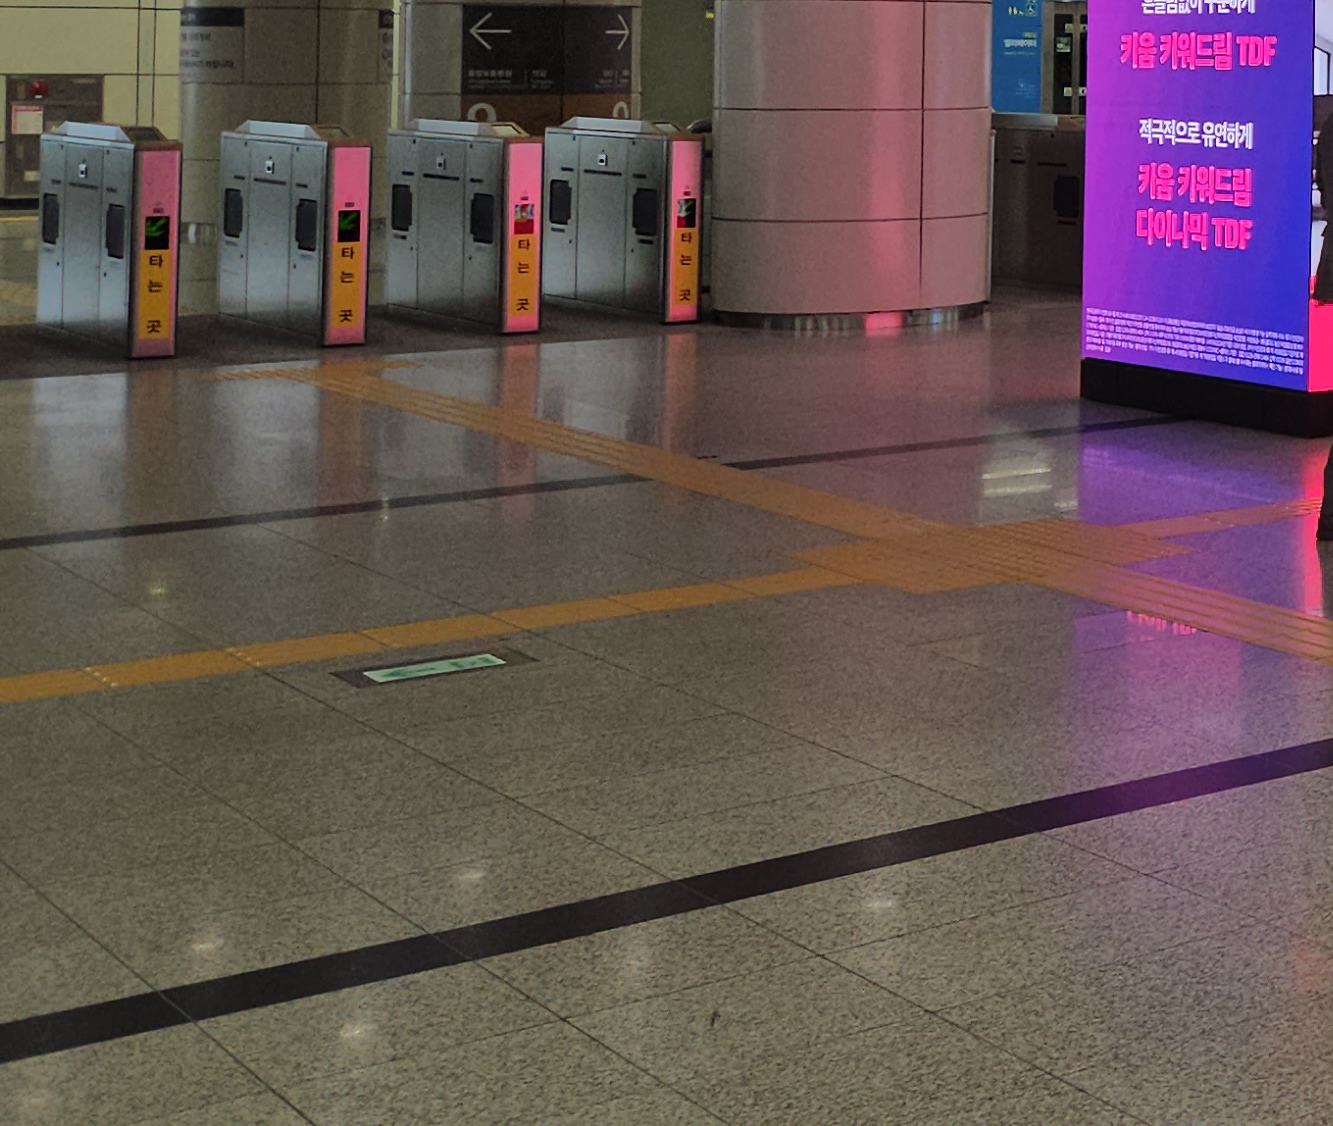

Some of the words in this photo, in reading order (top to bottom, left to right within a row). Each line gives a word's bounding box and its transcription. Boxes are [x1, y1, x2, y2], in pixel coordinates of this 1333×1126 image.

[1120, 30, 1157, 69] 키움
[1159, 31, 1233, 71] 키워드림
[1236, 36, 1278, 67] TDF
[1139, 117, 1201, 147] 적극적으로
[1202, 120, 1254, 151] 유연하게
[1138, 161, 1174, 202] 키움
[1177, 163, 1253, 208] 키워드림
[1136, 207, 1208, 251] 다이나믹
[1211, 215, 1254, 251] TDF
